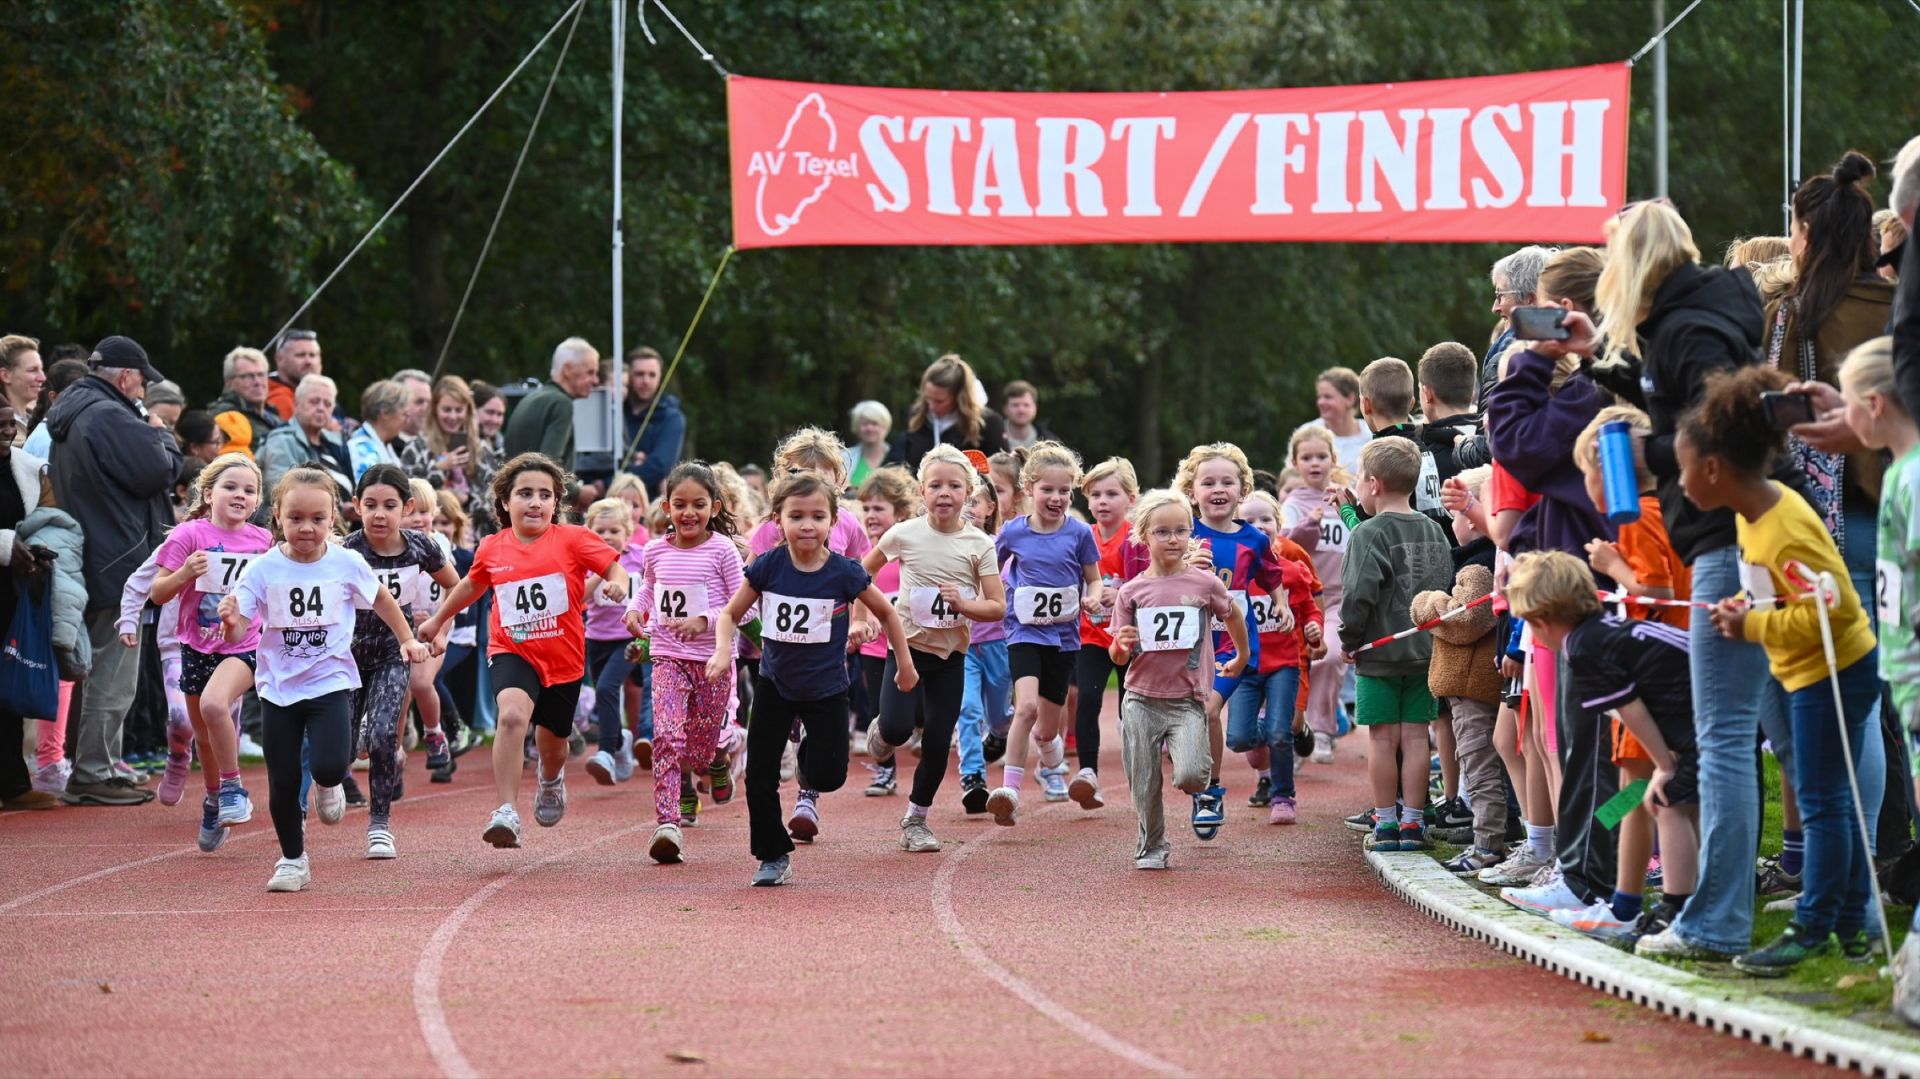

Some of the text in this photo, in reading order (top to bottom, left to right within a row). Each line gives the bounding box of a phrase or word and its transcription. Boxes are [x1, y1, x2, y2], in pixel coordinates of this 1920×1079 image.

[747, 151, 859, 177] AV Texel
[858, 98, 1611, 217] START/FINISH
[1320, 523, 1342, 546] 40
[289, 585, 324, 618] 84
[515, 582, 547, 615] 46
[660, 589, 688, 618] 42
[1032, 592, 1063, 618] 26
[291, 617, 320, 626] ALISA
[519, 609, 553, 623] DIANA
[775, 602, 810, 634] 82
[1153, 611, 1185, 642] 27
[286, 631, 326, 644] HIP HOP
[1156, 641, 1179, 650] NOX
